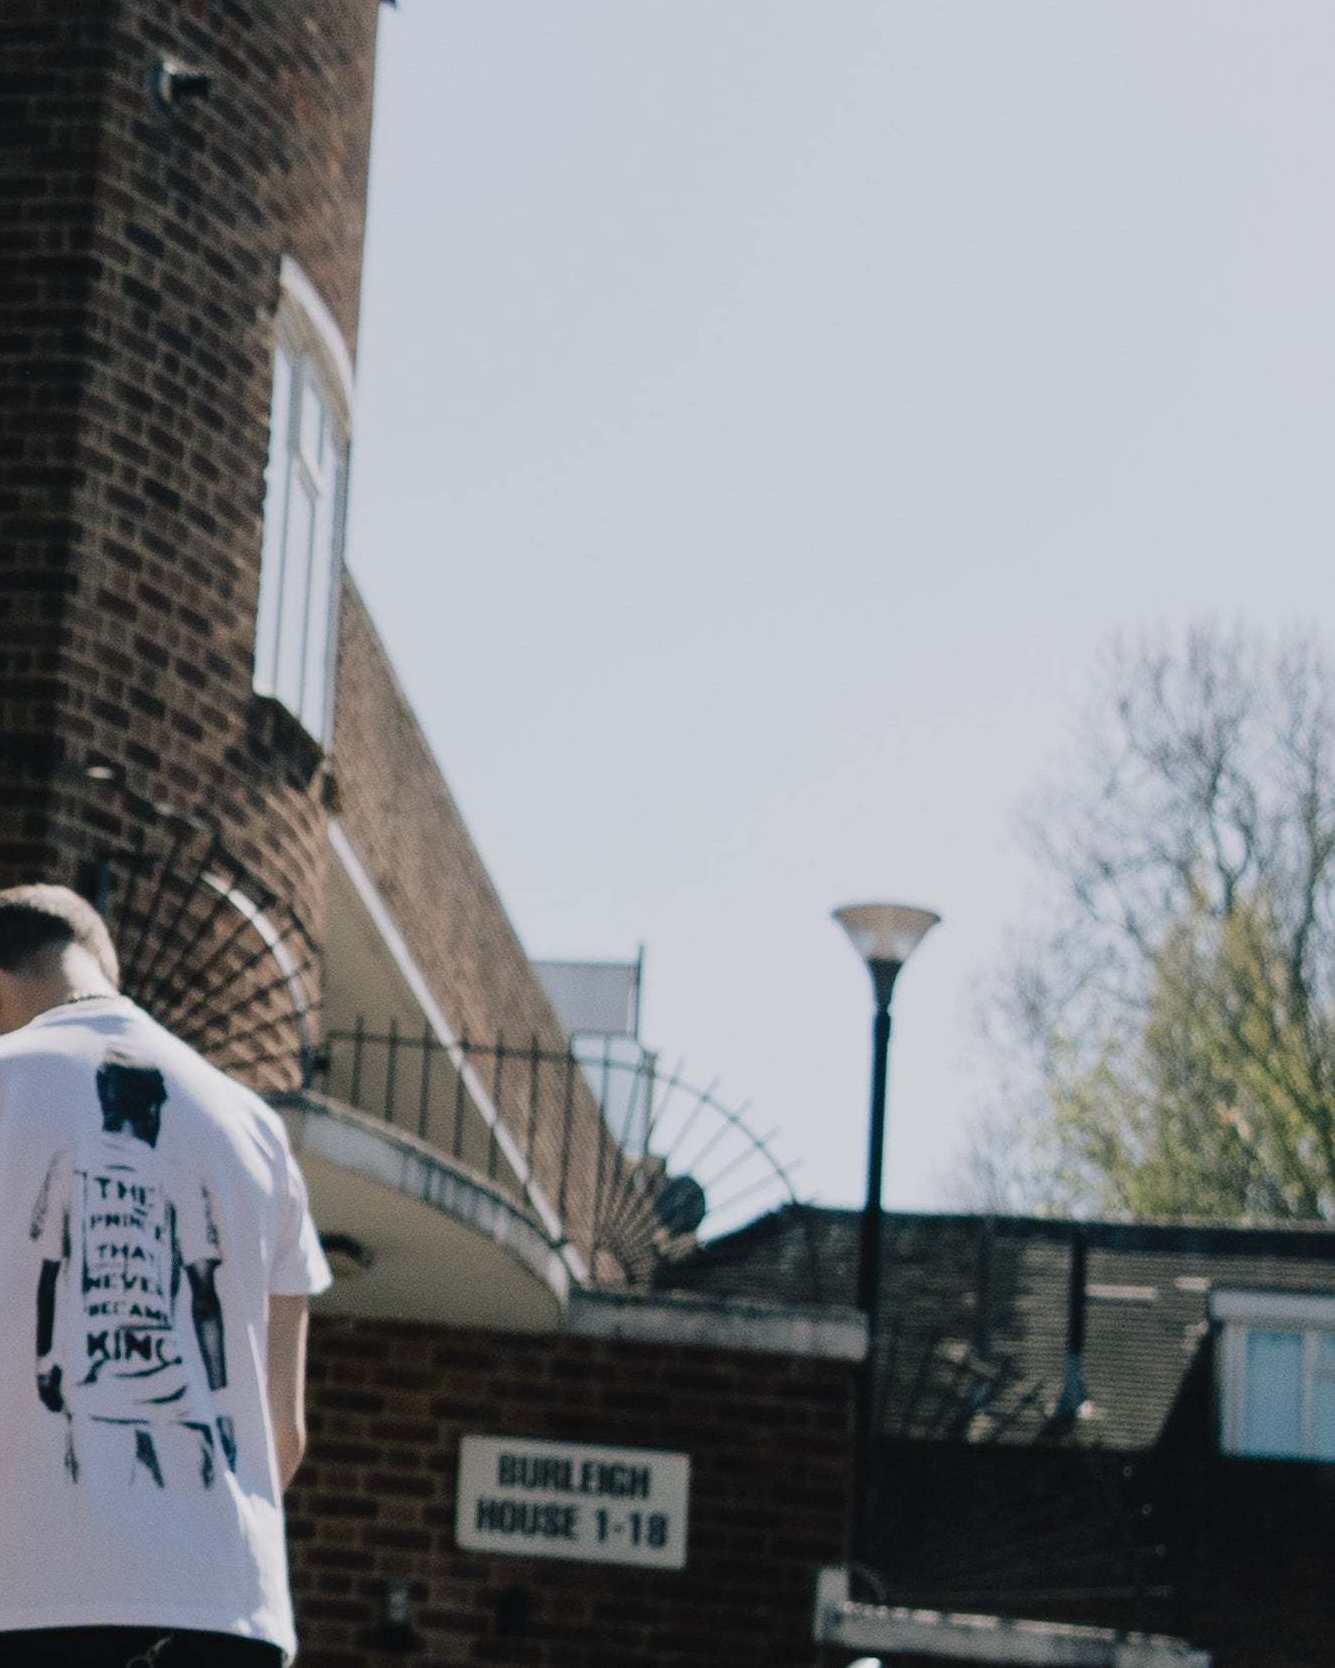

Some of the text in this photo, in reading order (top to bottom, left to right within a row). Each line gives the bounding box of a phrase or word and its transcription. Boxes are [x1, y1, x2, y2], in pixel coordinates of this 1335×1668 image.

[93, 1175, 156, 1208] THE
[498, 1452, 652, 1500] BURLEIGH
[476, 1496, 669, 1550] HOUSE 1-18
